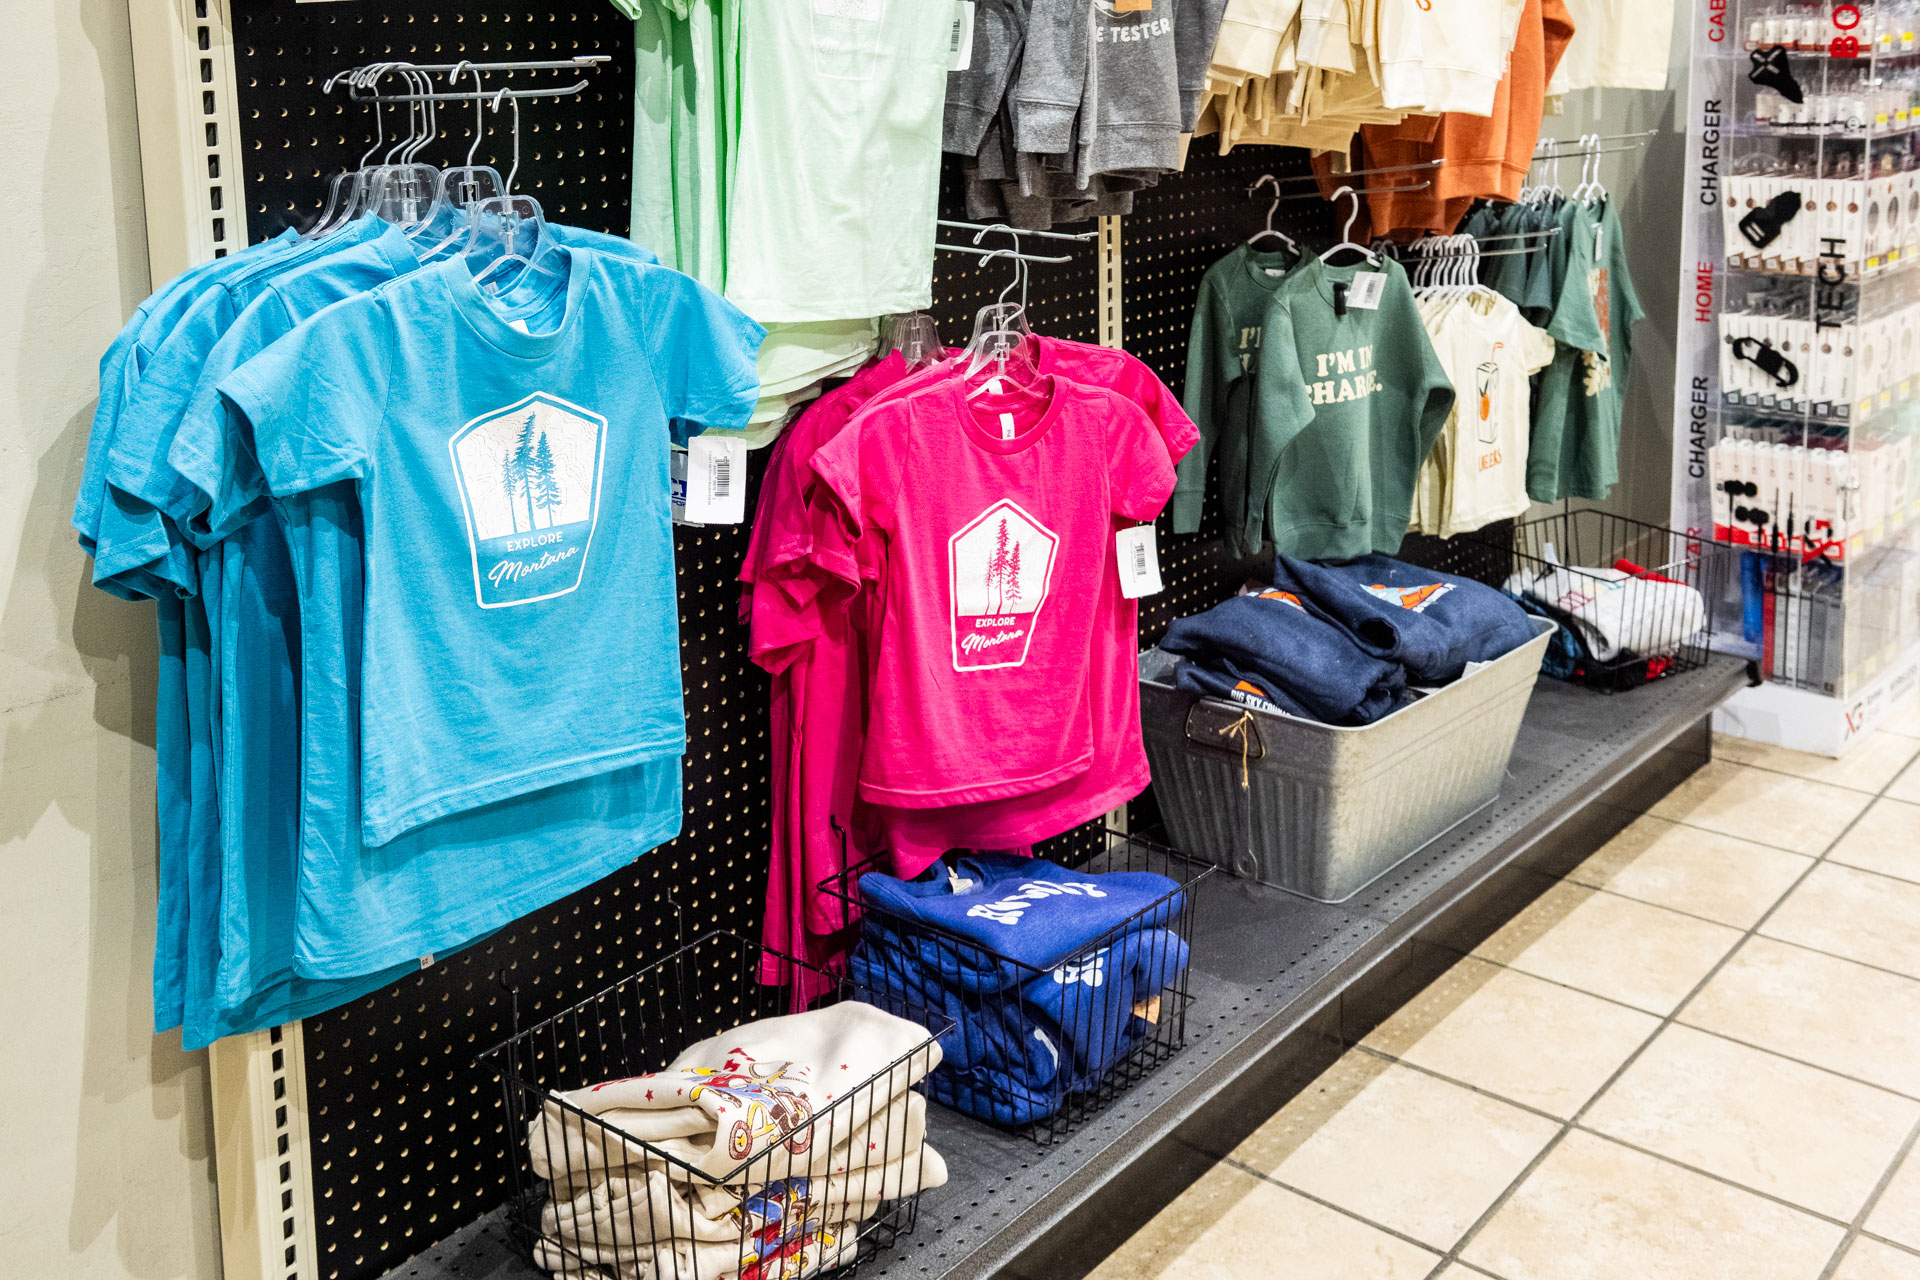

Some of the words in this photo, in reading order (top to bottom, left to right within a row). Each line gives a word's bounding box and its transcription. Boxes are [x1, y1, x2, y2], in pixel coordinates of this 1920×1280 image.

[1110, 18, 1171, 43] TESTER
[1700, 99, 1722, 206] CHARGER
[1695, 261, 1714, 323] HOME
[1815, 238, 1846, 334] TECH
[1316, 349, 1356, 377] I'M
[1358, 344, 1373, 370] IN
[1688, 376, 1709, 479] CHARGER
[506, 531, 564, 552] EXPLORE
[488, 547, 579, 588] Montana
[975, 616, 1016, 628] EXPLORE
[961, 629, 1024, 655] Montana
[1245, 694, 1262, 709] SKY
